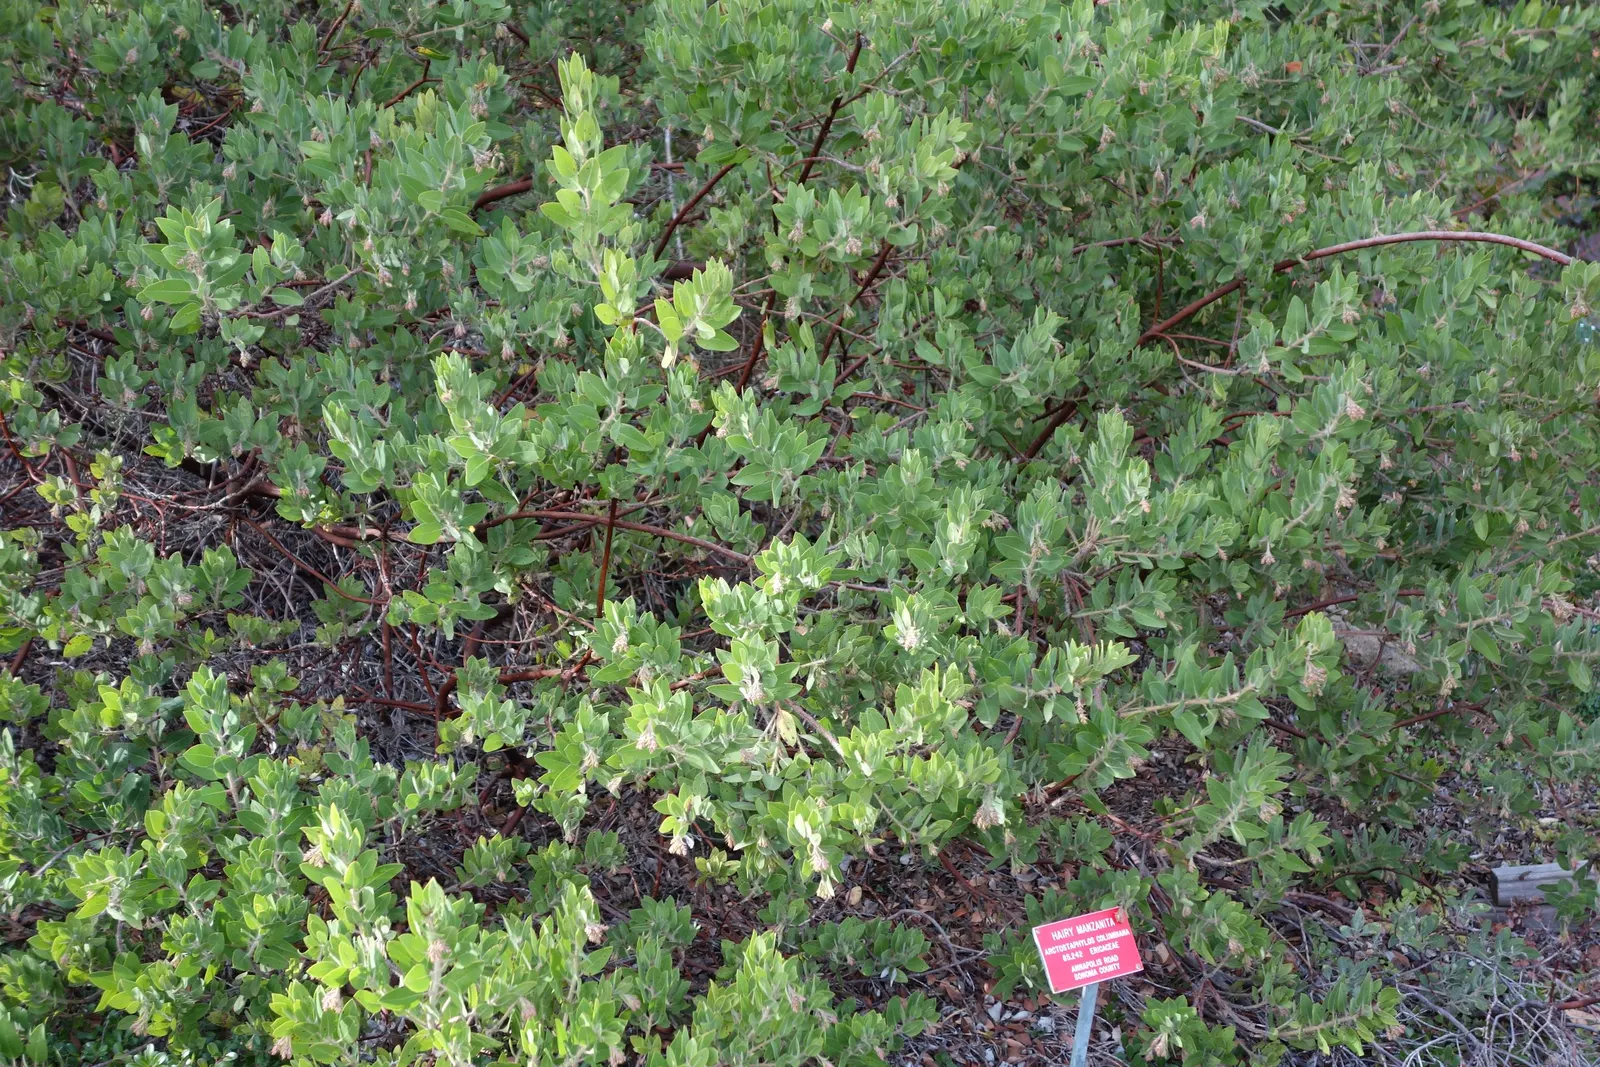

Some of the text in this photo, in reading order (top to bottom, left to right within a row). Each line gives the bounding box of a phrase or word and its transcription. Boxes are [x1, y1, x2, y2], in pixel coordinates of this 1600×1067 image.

[1051, 917, 1116, 941] HAIRY MANZANITA
[1044, 936, 1095, 956] ARCTOSTAPHYLOS
[1089, 941, 1120, 955] ERICACEAE
[1071, 954, 1119, 973] ANNAPOLIS ROAD
[1073, 963, 1120, 981] SONOMA COUNTY
